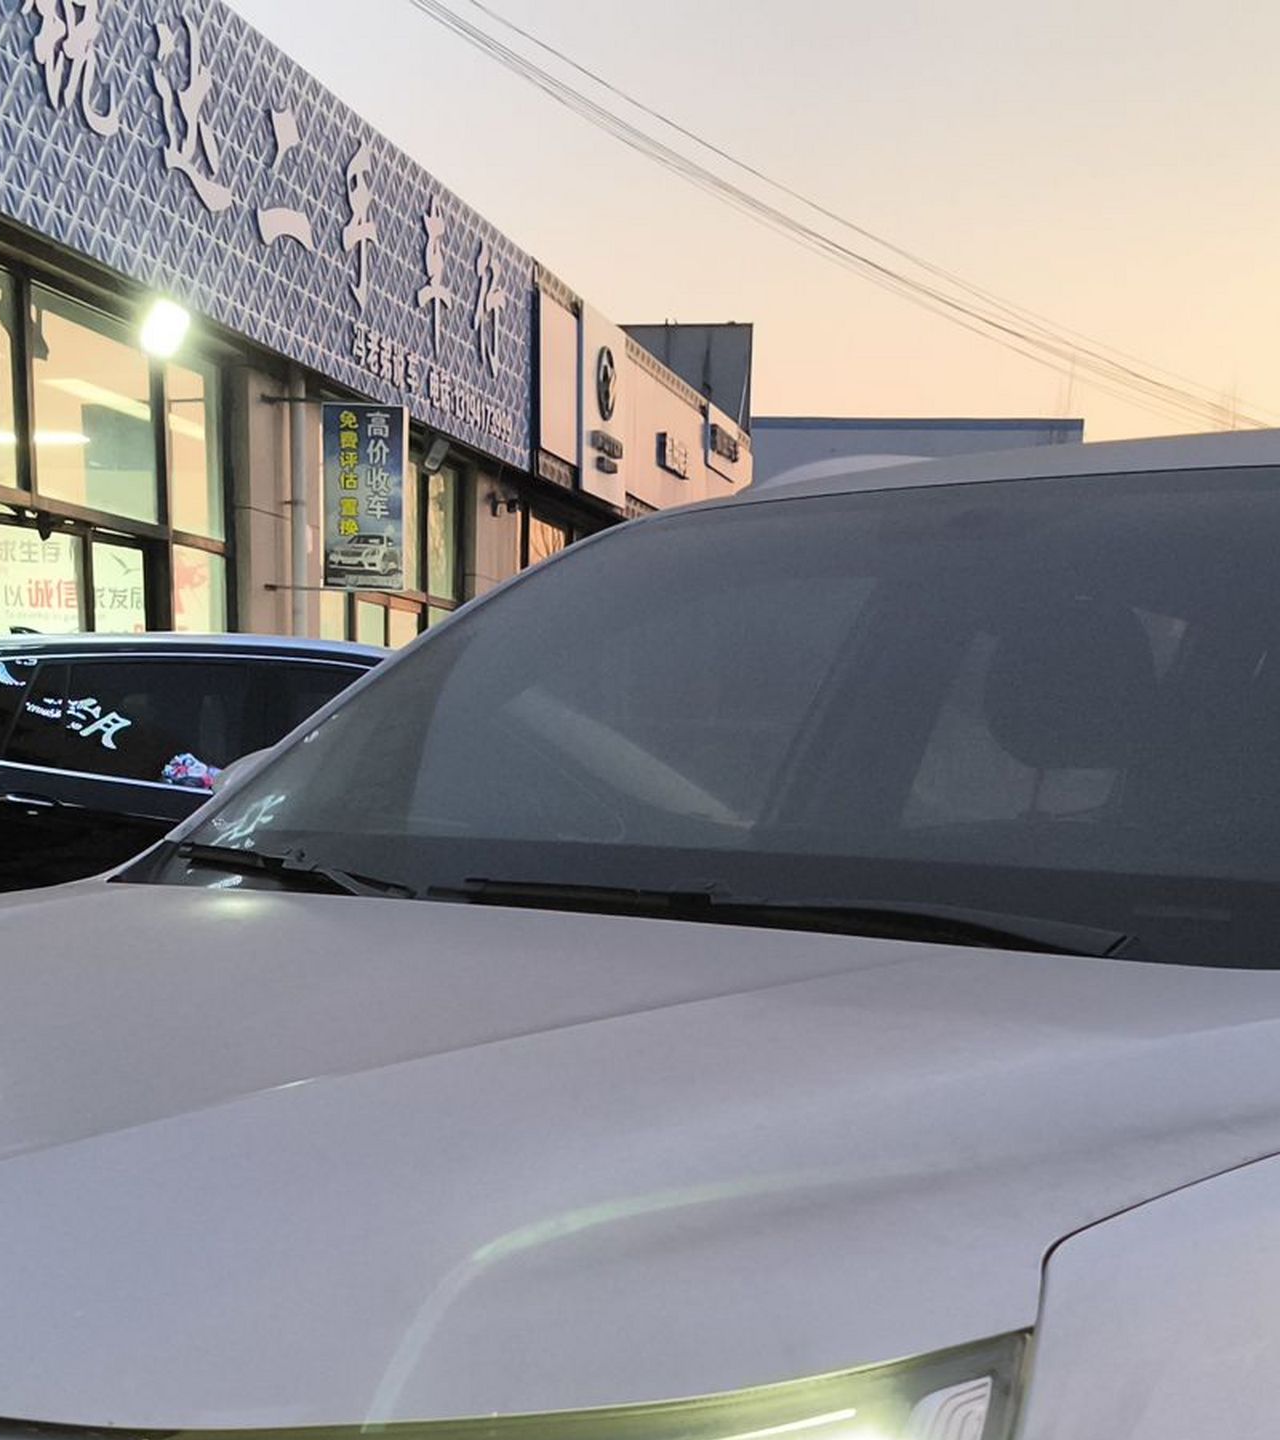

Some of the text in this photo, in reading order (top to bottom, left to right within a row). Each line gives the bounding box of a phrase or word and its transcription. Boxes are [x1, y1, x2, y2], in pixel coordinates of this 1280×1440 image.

[339, 410, 359, 536] 免费评估 置换
[366, 411, 391, 519] 高价收车
